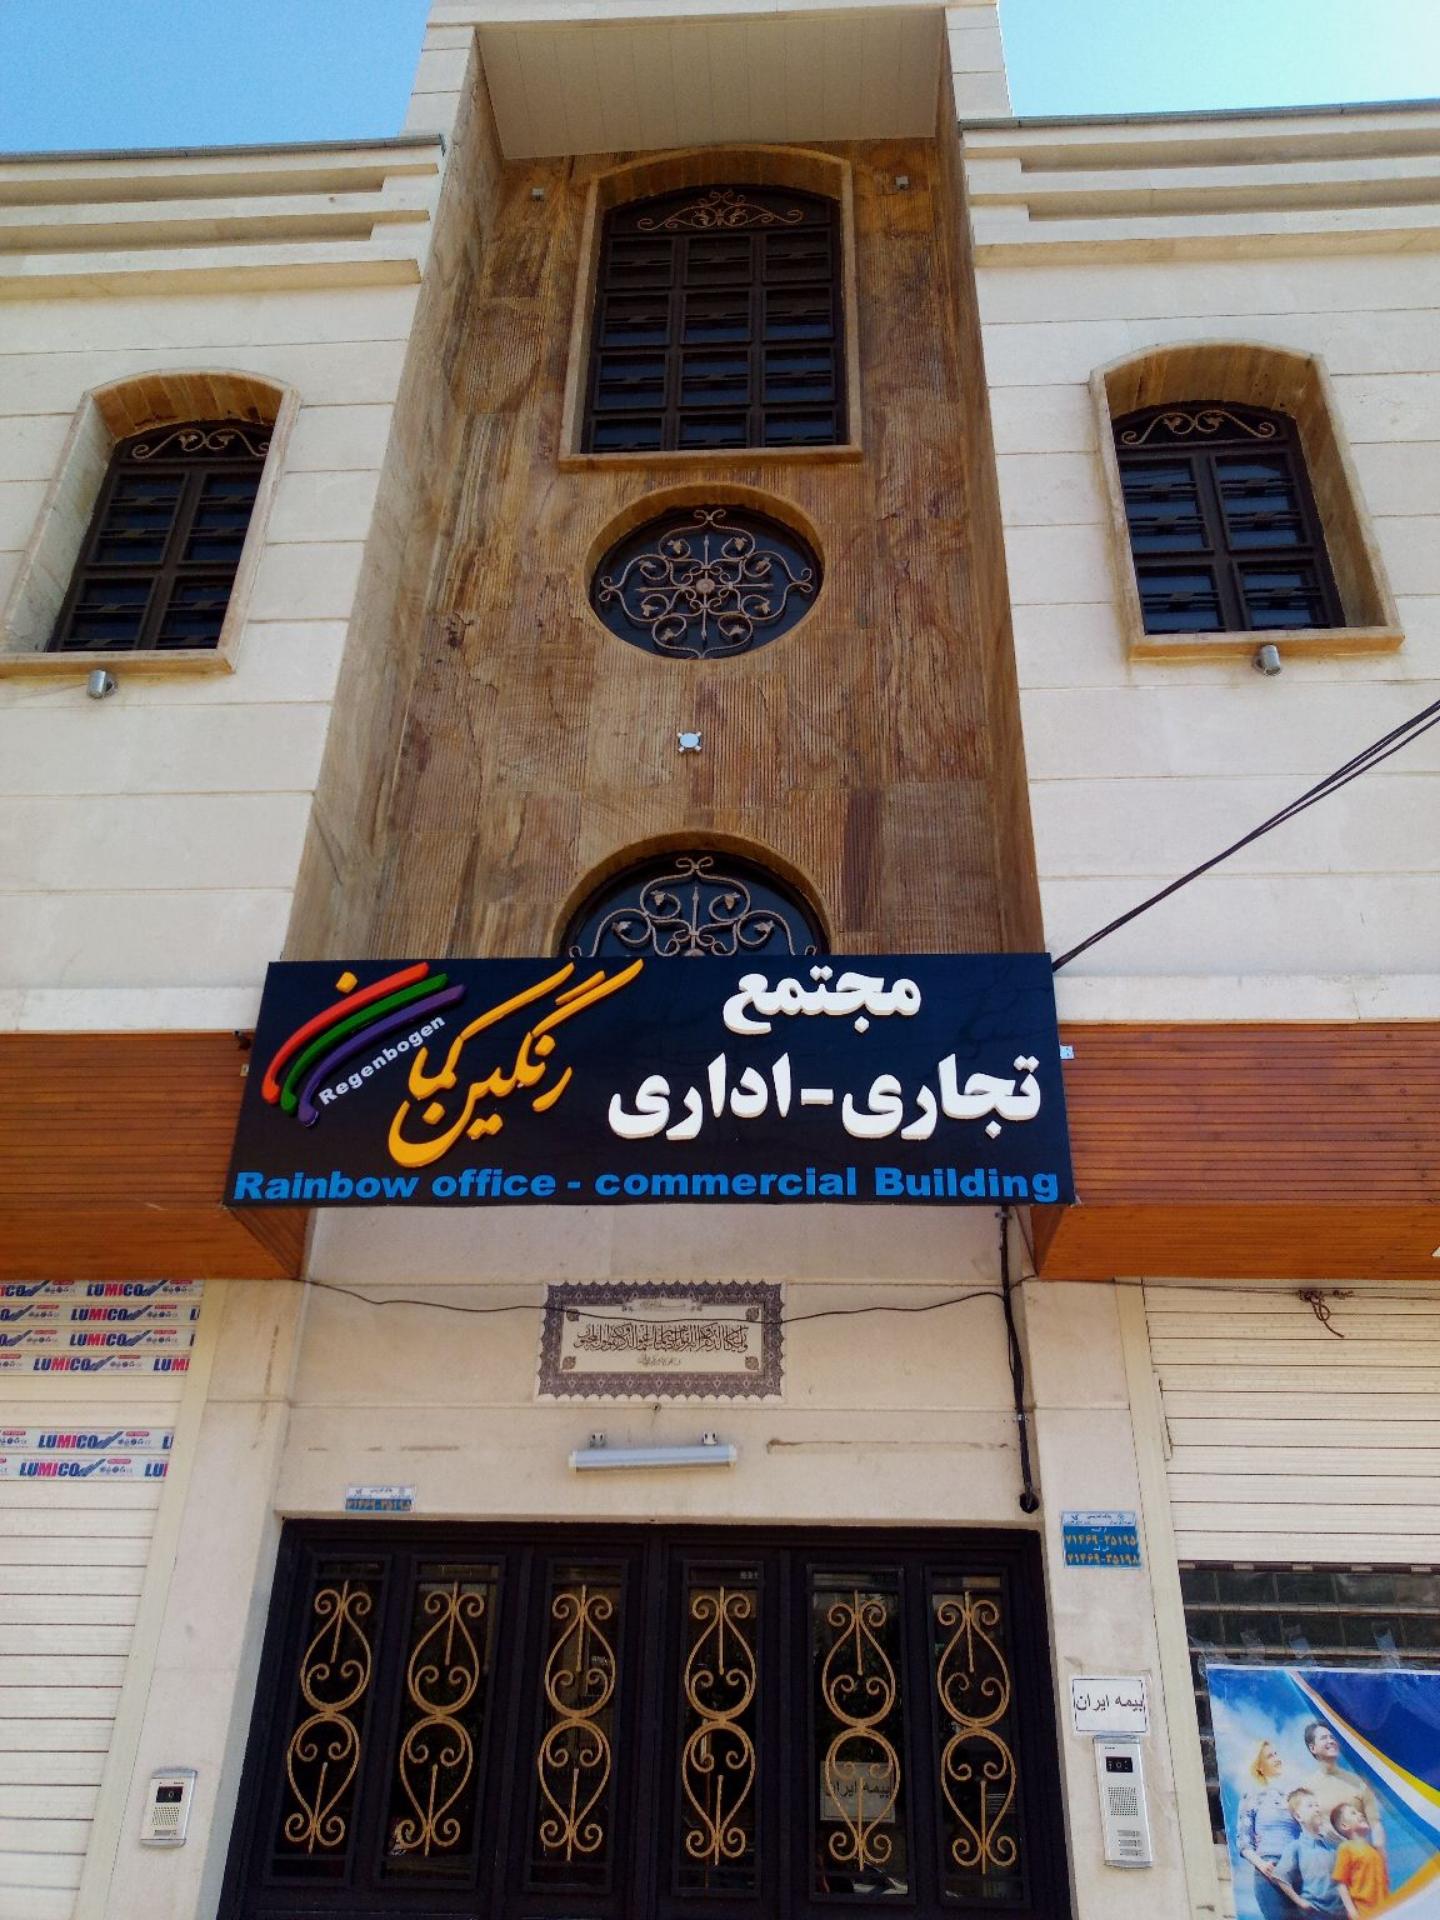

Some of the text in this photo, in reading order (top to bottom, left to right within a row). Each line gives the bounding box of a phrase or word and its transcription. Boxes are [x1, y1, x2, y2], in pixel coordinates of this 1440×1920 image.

[723, 965, 921, 1035] مجتمع
[318, 1017, 445, 1105] Regenbogen
[234, 1171, 420, 1200] Rainbow
[432, 1169, 556, 1197] office
[595, 1167, 857, 1197] commercial
[875, 1168, 1058, 1202] Building
[87, 1284, 144, 1297] LUMICO
[71, 1308, 128, 1321] LUMICO
[70, 1333, 127, 1347] LUMICO
[33, 1358, 91, 1371] LUMICO
[38, 1435, 97, 1449] LUMICO
[20, 1462, 80, 1477] LUMICO
[1076, 1694, 1143, 1712] بیمه ایران
